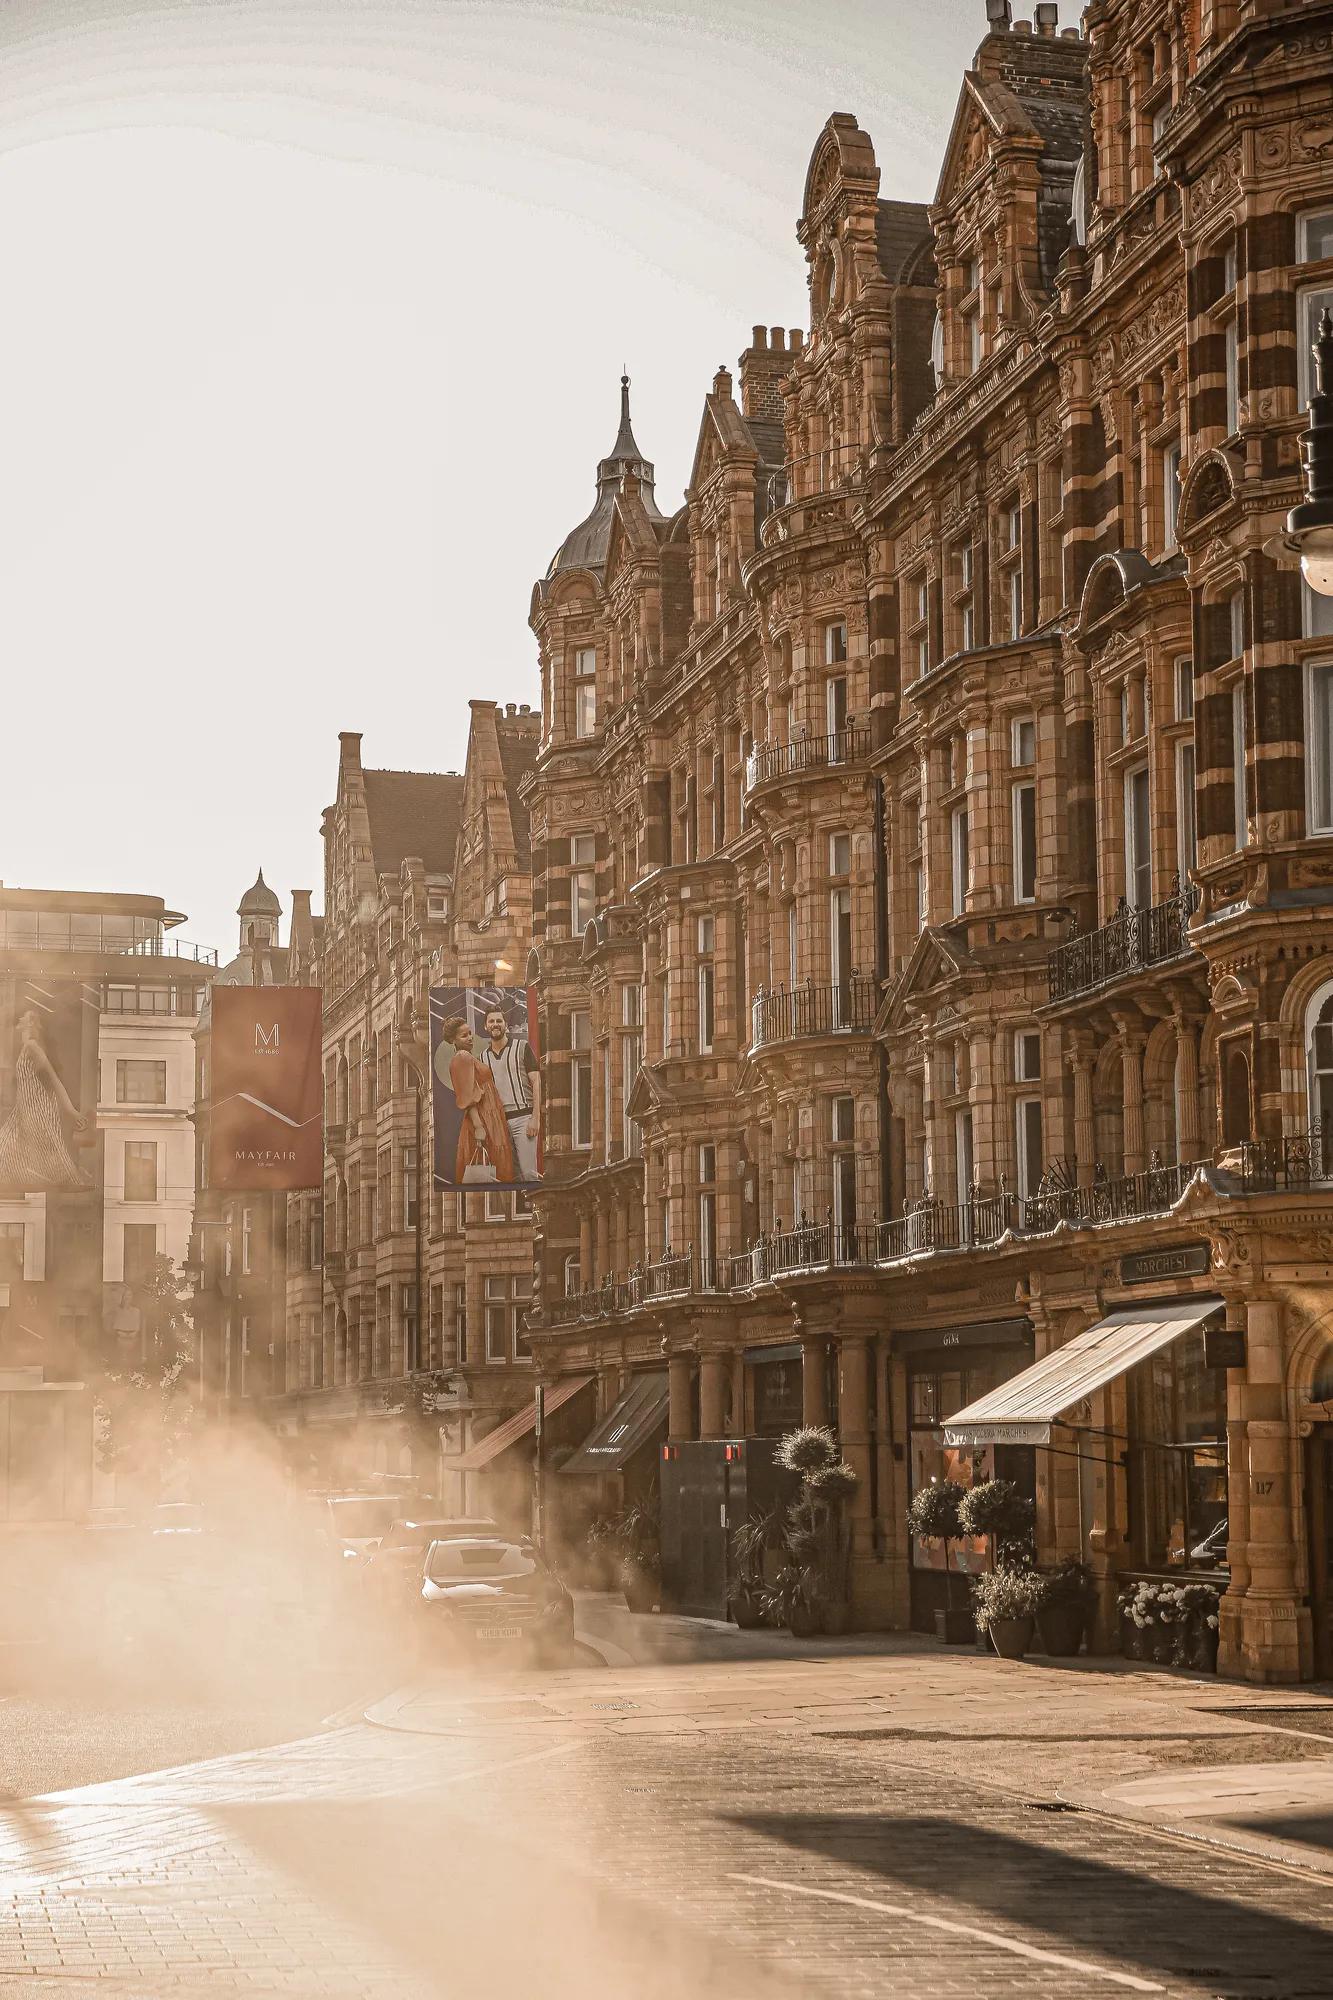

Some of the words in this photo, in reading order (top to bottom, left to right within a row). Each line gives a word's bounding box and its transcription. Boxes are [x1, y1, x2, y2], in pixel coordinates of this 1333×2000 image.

[255, 1023, 279, 1046] M
[235, 1150, 296, 1160] MAYFAIR
[1135, 1254, 1186, 1274] MARCHESI
[1255, 1481, 1274, 1495] 117
